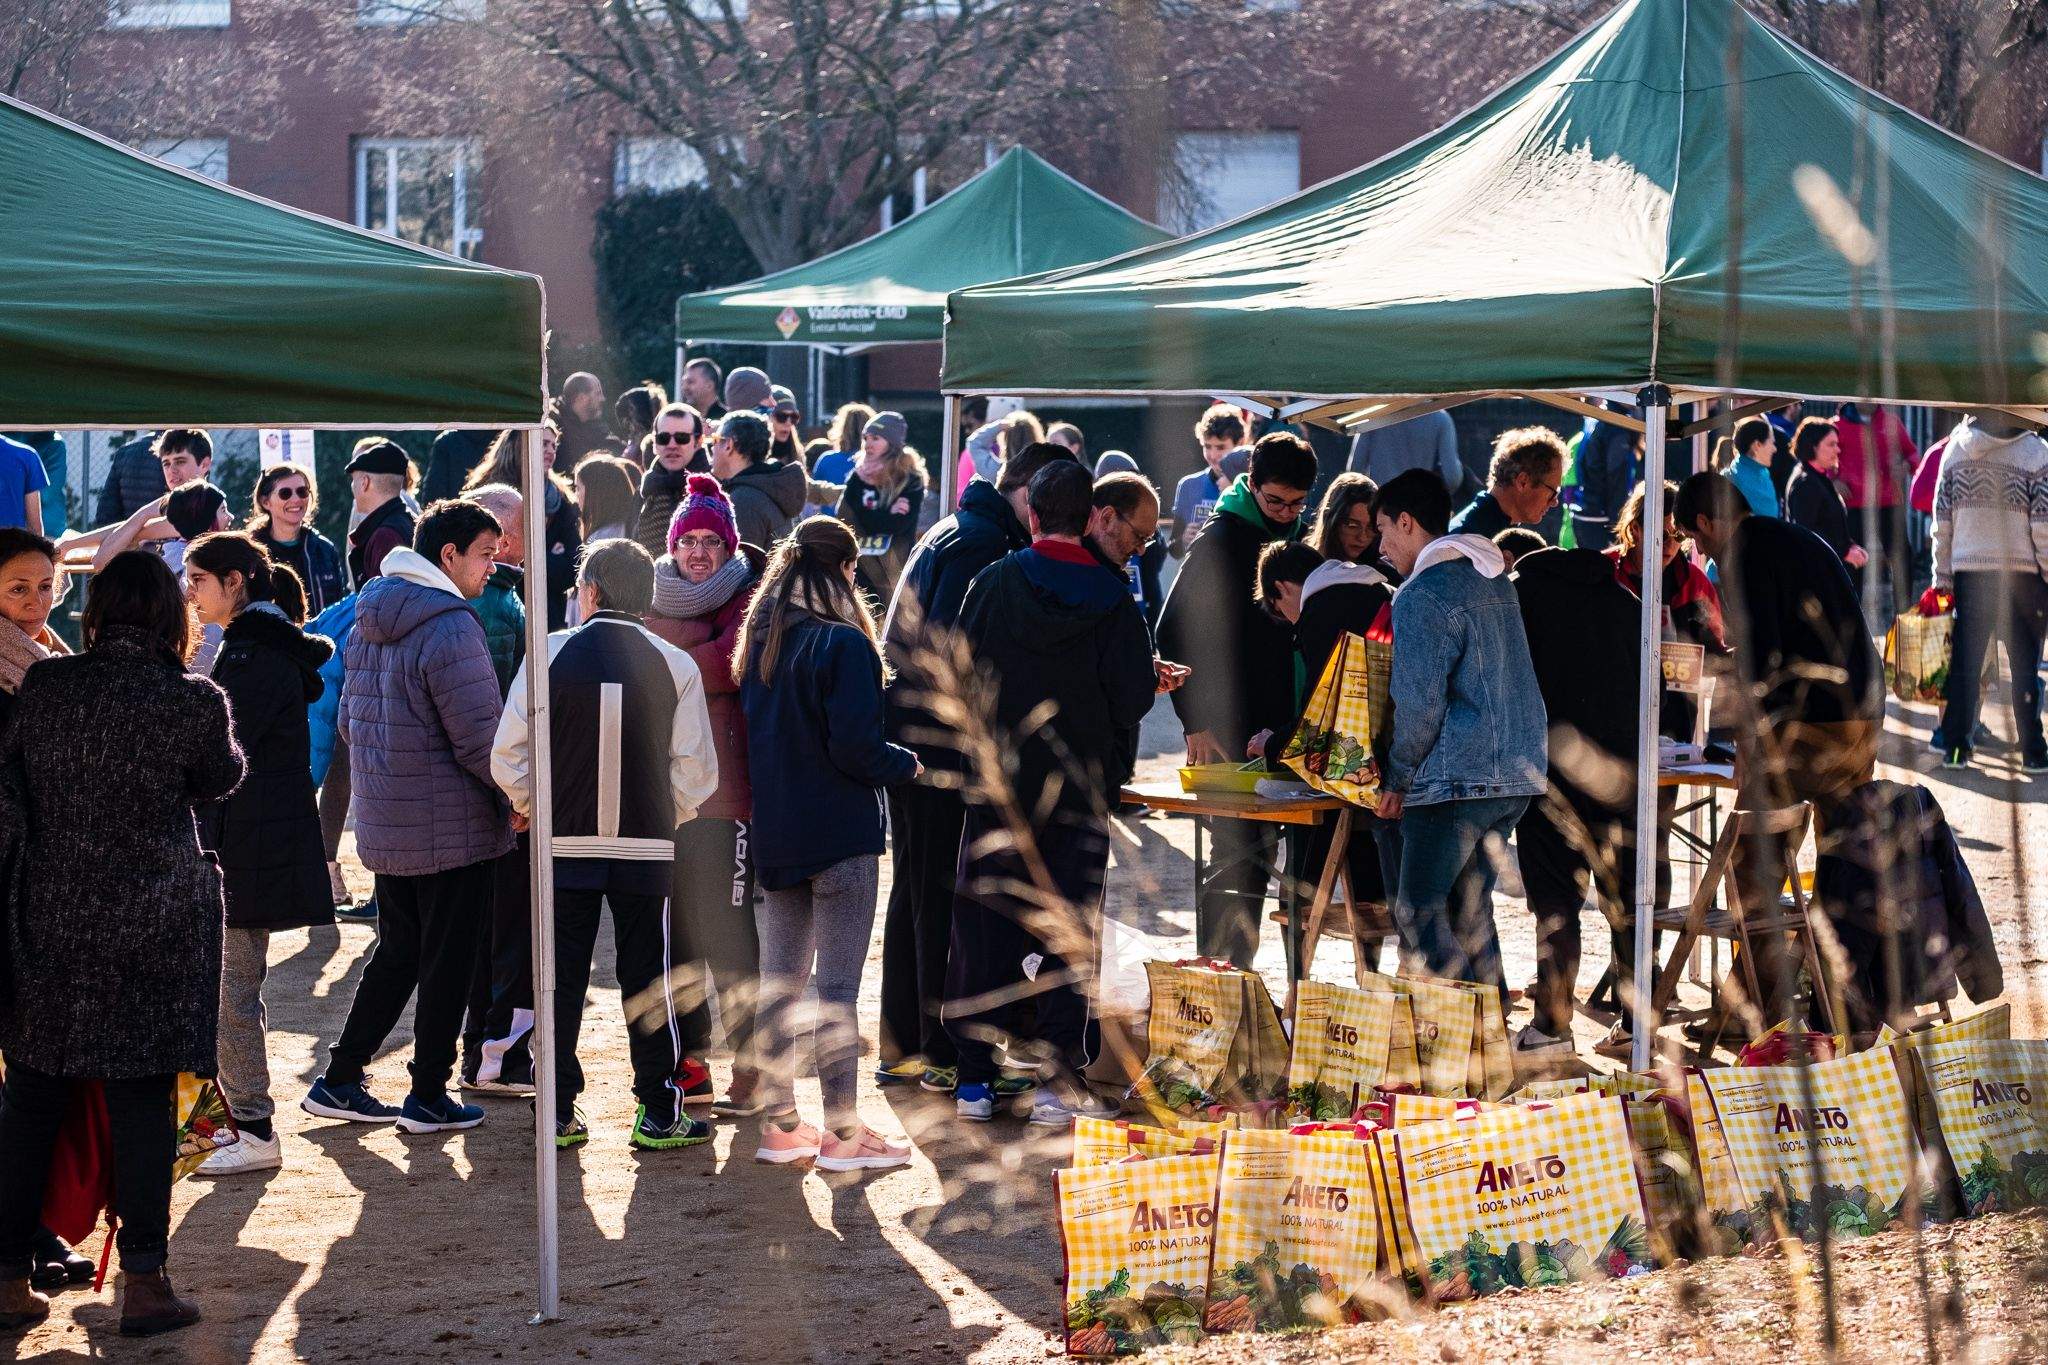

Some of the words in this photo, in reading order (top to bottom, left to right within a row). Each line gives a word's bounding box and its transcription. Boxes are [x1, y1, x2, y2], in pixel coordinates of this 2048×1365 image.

[732, 819, 748, 906] GIVOV
[1778, 1140, 1805, 1152] 100%
[1475, 1155, 1565, 1194] ANETO
[1282, 1176, 1348, 1212] ANETO
[1477, 1199, 1507, 1214] 100%
[1510, 1184, 1569, 1208] NATURAL
[1128, 1201, 1213, 1233] ANETO
[1281, 1215, 1302, 1227] 100%
[1304, 1218, 1345, 1231] NATURAL
[1486, 1206, 1569, 1230] www.caldoaneto.com
[1129, 1239, 1157, 1252] 100%
[1134, 1256, 1209, 1269] www.caldoaneto.com
